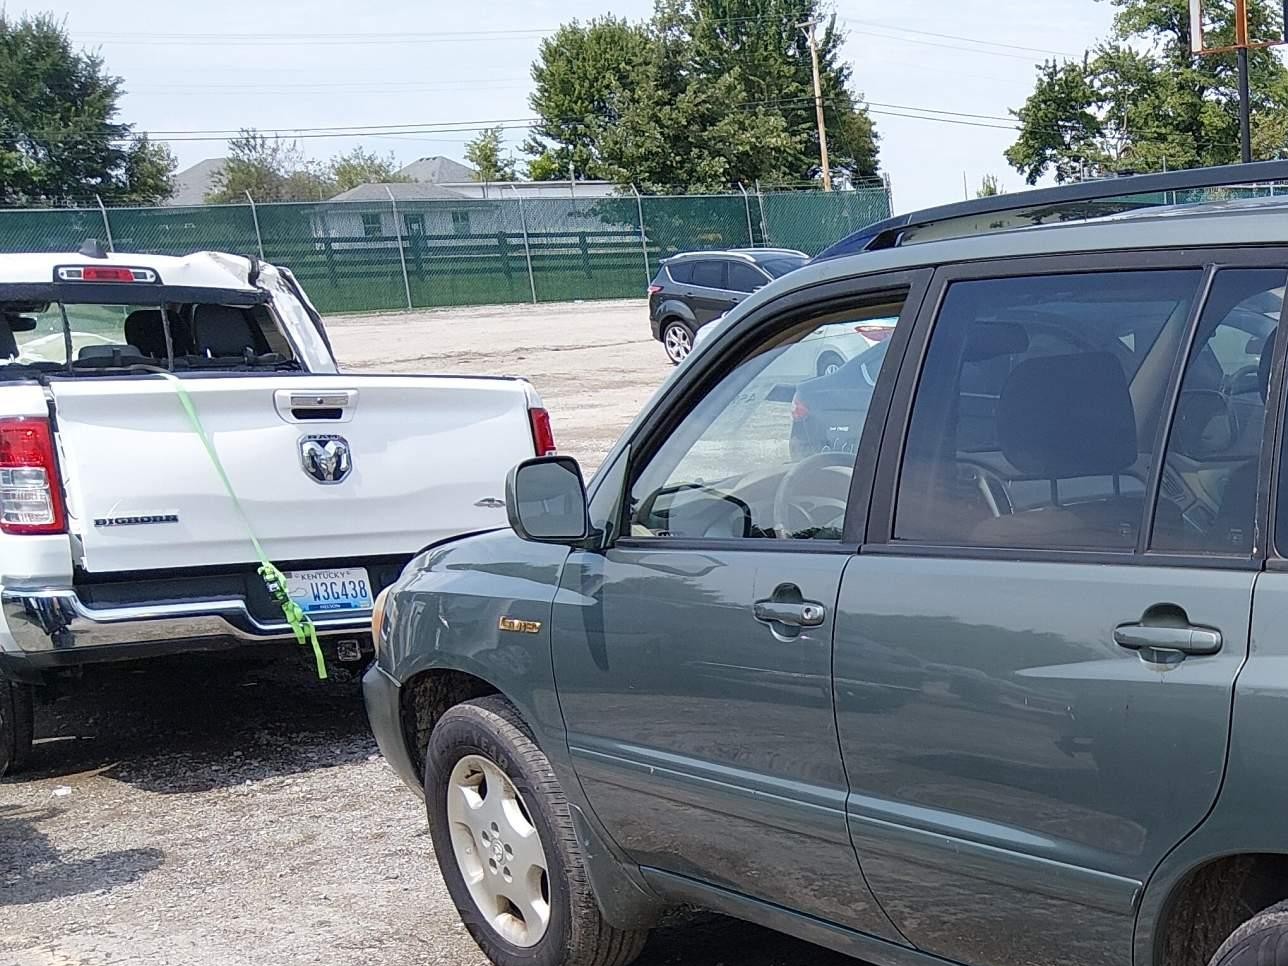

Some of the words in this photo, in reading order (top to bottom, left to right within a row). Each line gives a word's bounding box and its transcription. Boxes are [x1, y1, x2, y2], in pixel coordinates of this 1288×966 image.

[93, 514, 180, 528] BIGHORN
[300, 570, 346, 581] KENTUCKY
[309, 579, 368, 602] W3G438
